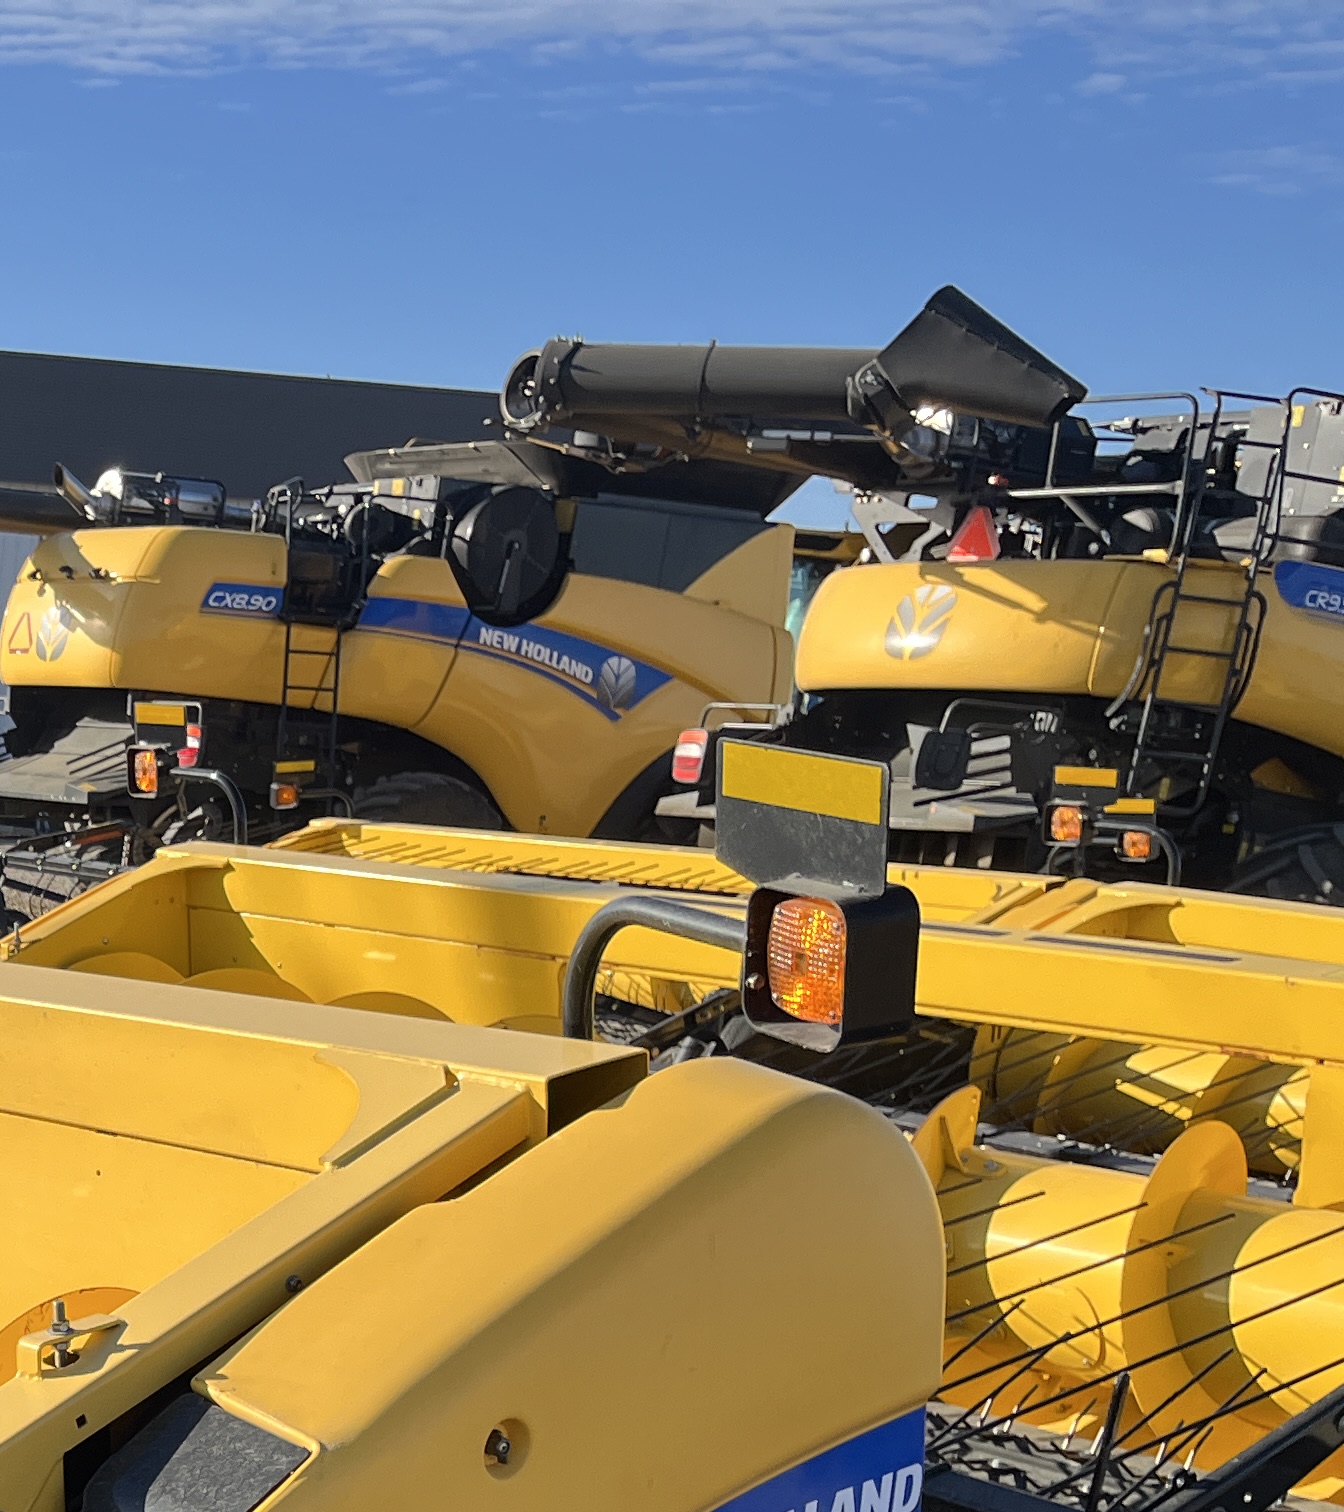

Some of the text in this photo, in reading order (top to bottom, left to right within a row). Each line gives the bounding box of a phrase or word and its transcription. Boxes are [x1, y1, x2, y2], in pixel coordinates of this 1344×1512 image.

[208, 591, 277, 612] CX8.90
[479, 626, 594, 684] NEW HOLLAND
